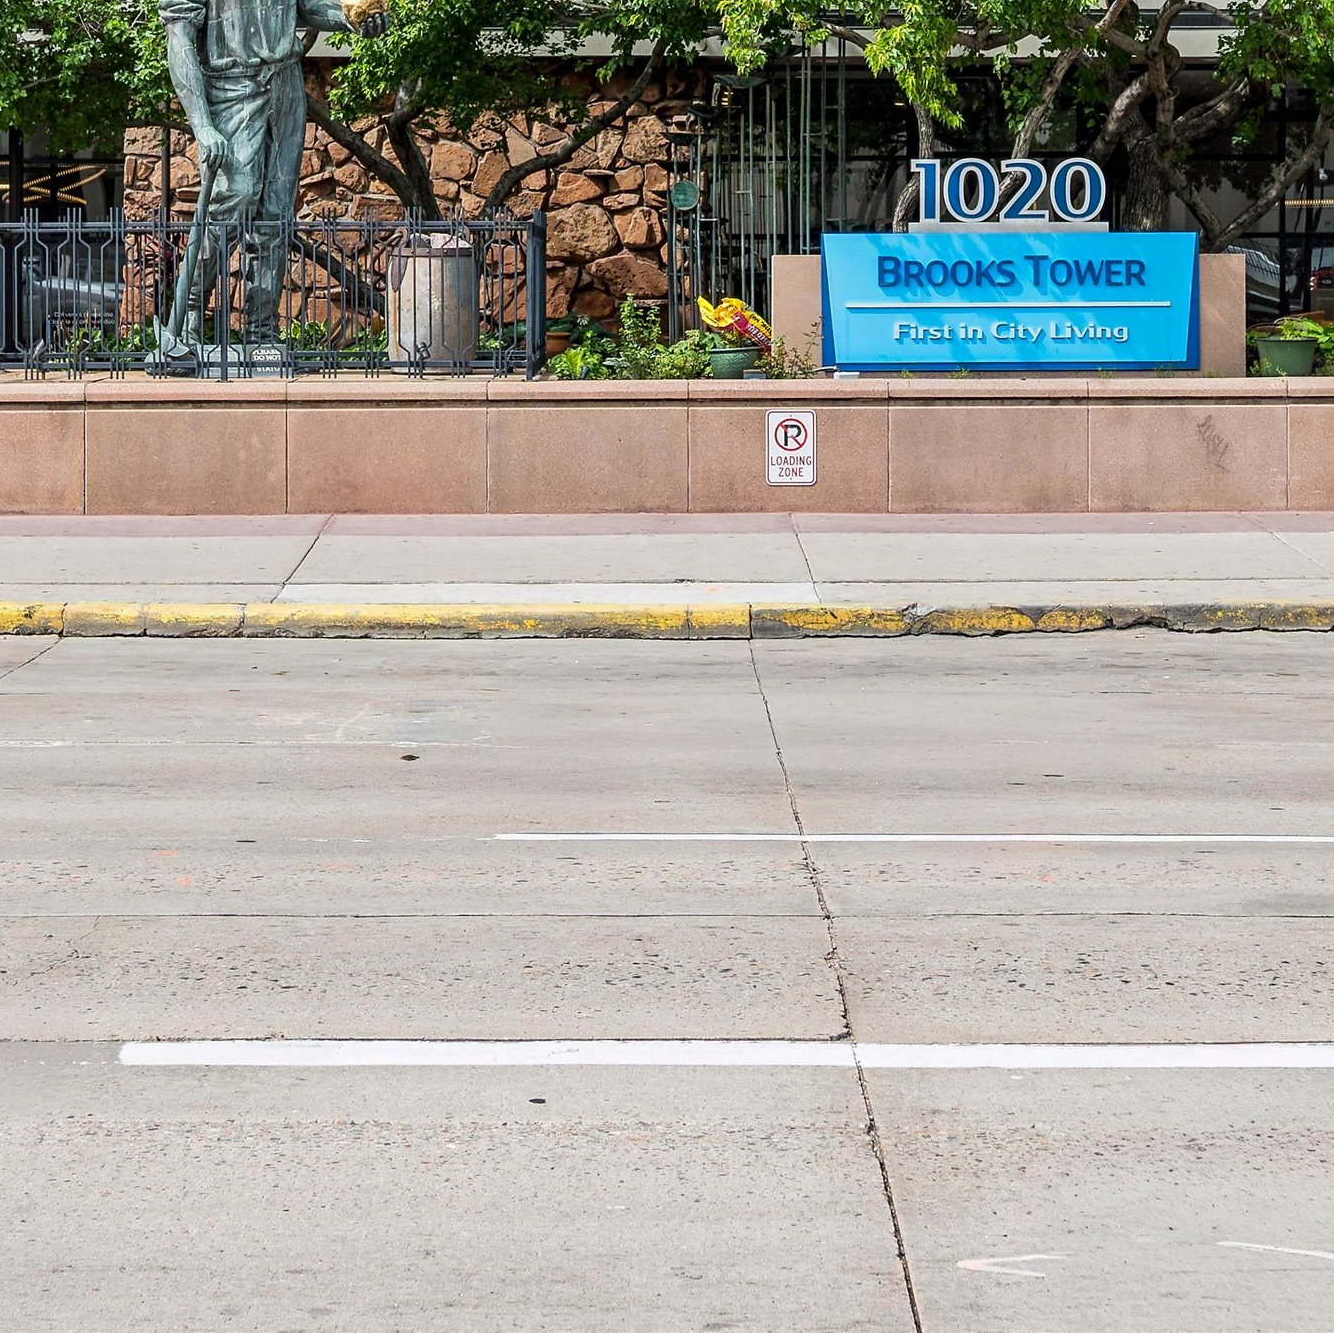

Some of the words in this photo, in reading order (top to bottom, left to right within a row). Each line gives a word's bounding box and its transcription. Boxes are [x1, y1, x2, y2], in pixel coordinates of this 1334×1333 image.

[910, 157, 1106, 223] 1020
[892, 321, 952, 341] First
[959, 321, 983, 340] in
[991, 321, 1044, 342] City
[1049, 321, 1129, 342] Living
[770, 456, 812, 466] LOADING
[778, 467, 804, 478] ZONE
